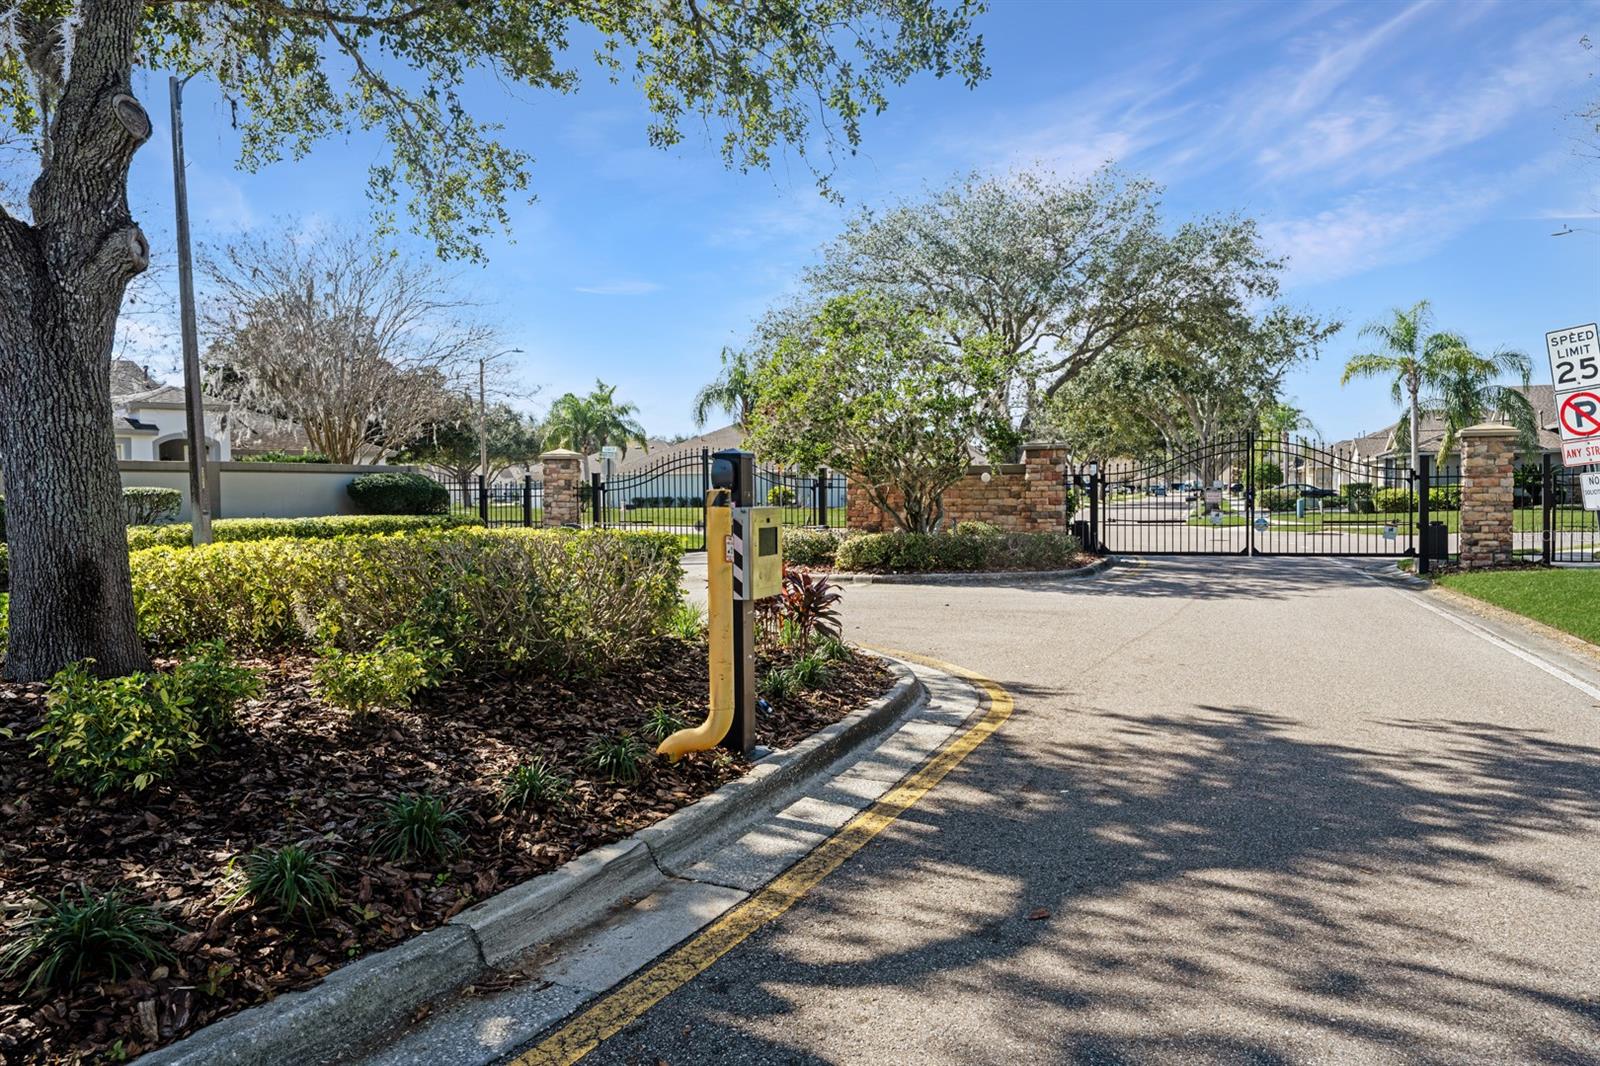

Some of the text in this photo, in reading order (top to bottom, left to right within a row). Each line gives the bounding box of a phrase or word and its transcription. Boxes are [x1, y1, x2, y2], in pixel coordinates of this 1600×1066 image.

[1551, 330, 1594, 347] SPEED
[1557, 343, 1591, 359] LIMIT
[1556, 356, 1599, 384] 25
[1566, 447, 1582, 458] ANY
[1588, 475, 1600, 485] NO
